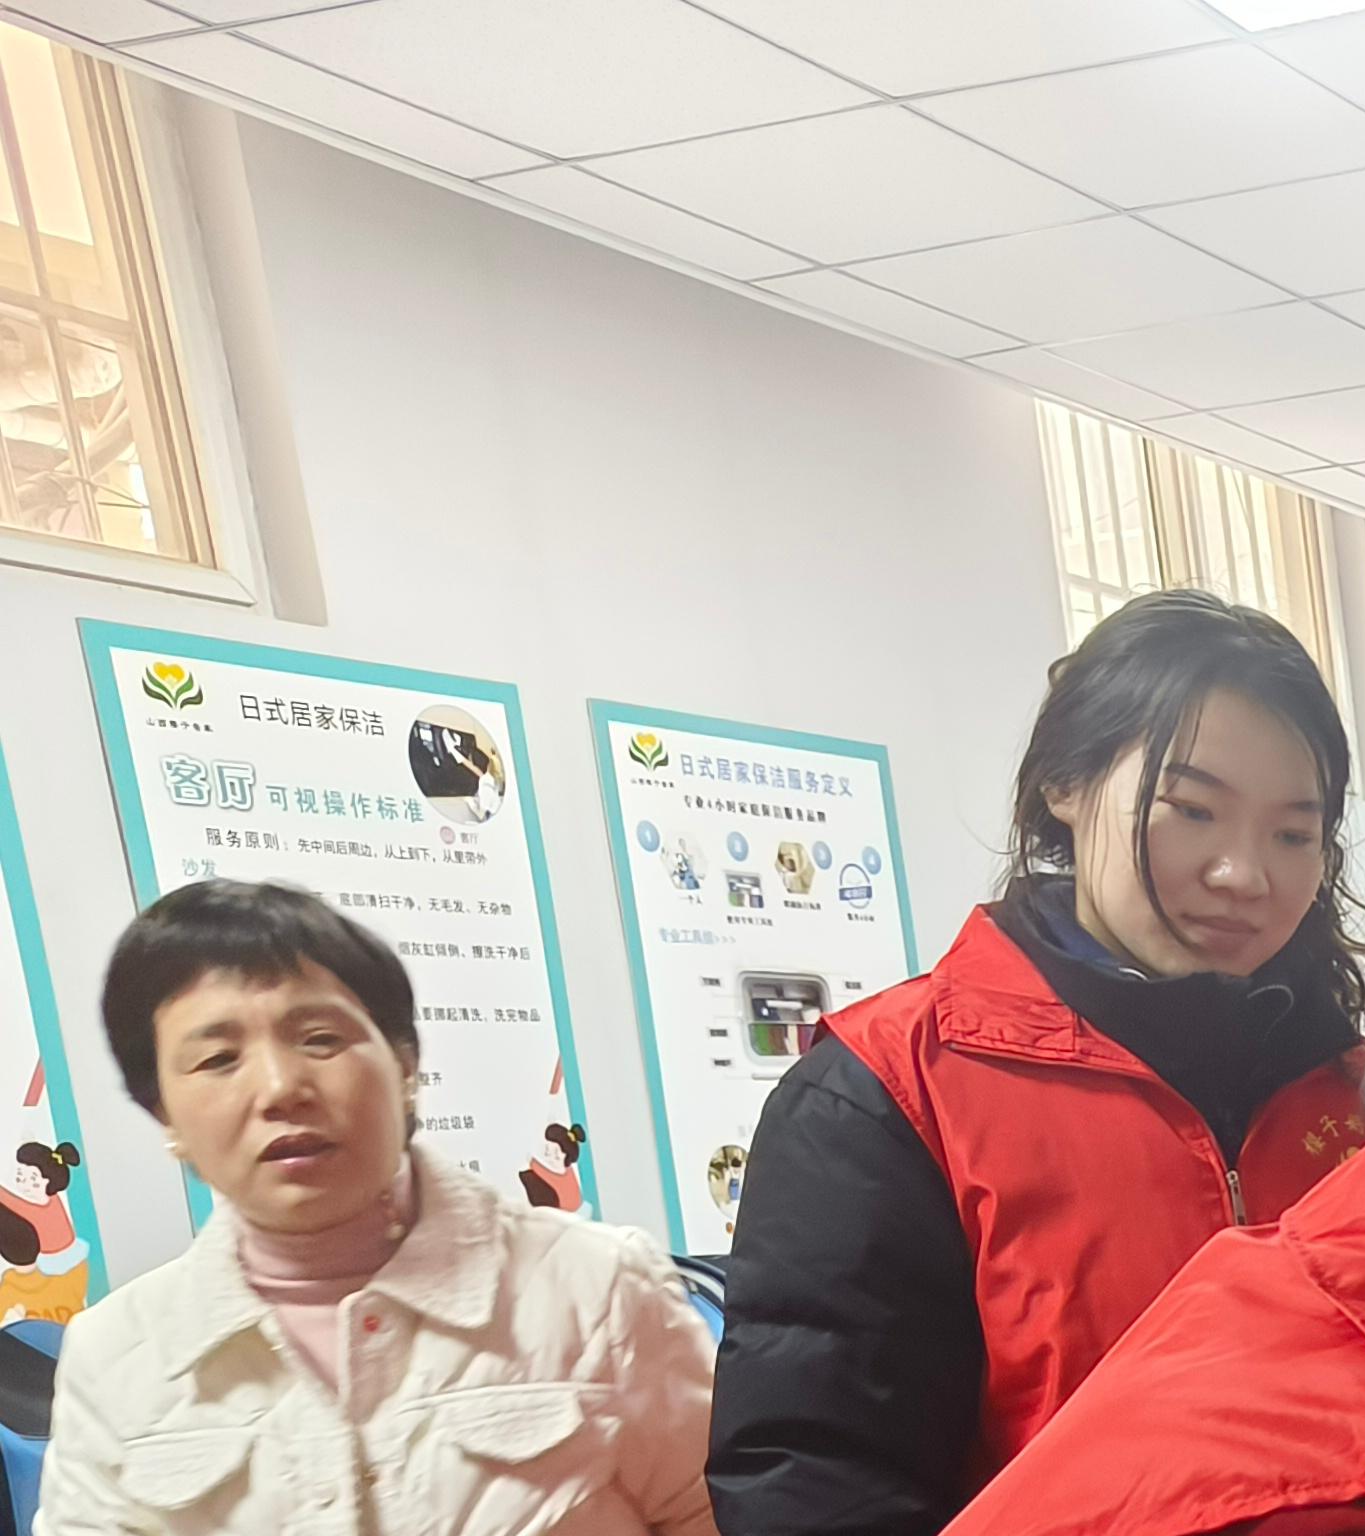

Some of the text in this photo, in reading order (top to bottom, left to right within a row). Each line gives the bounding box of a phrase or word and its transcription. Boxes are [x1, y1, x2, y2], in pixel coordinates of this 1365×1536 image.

[240, 694, 385, 737] 日式居家保洁
[162, 754, 425, 824] 客厅 可视操作标准
[680, 753, 854, 798] 日式居家保洁服务定义
[181, 857, 217, 877] 沙发
